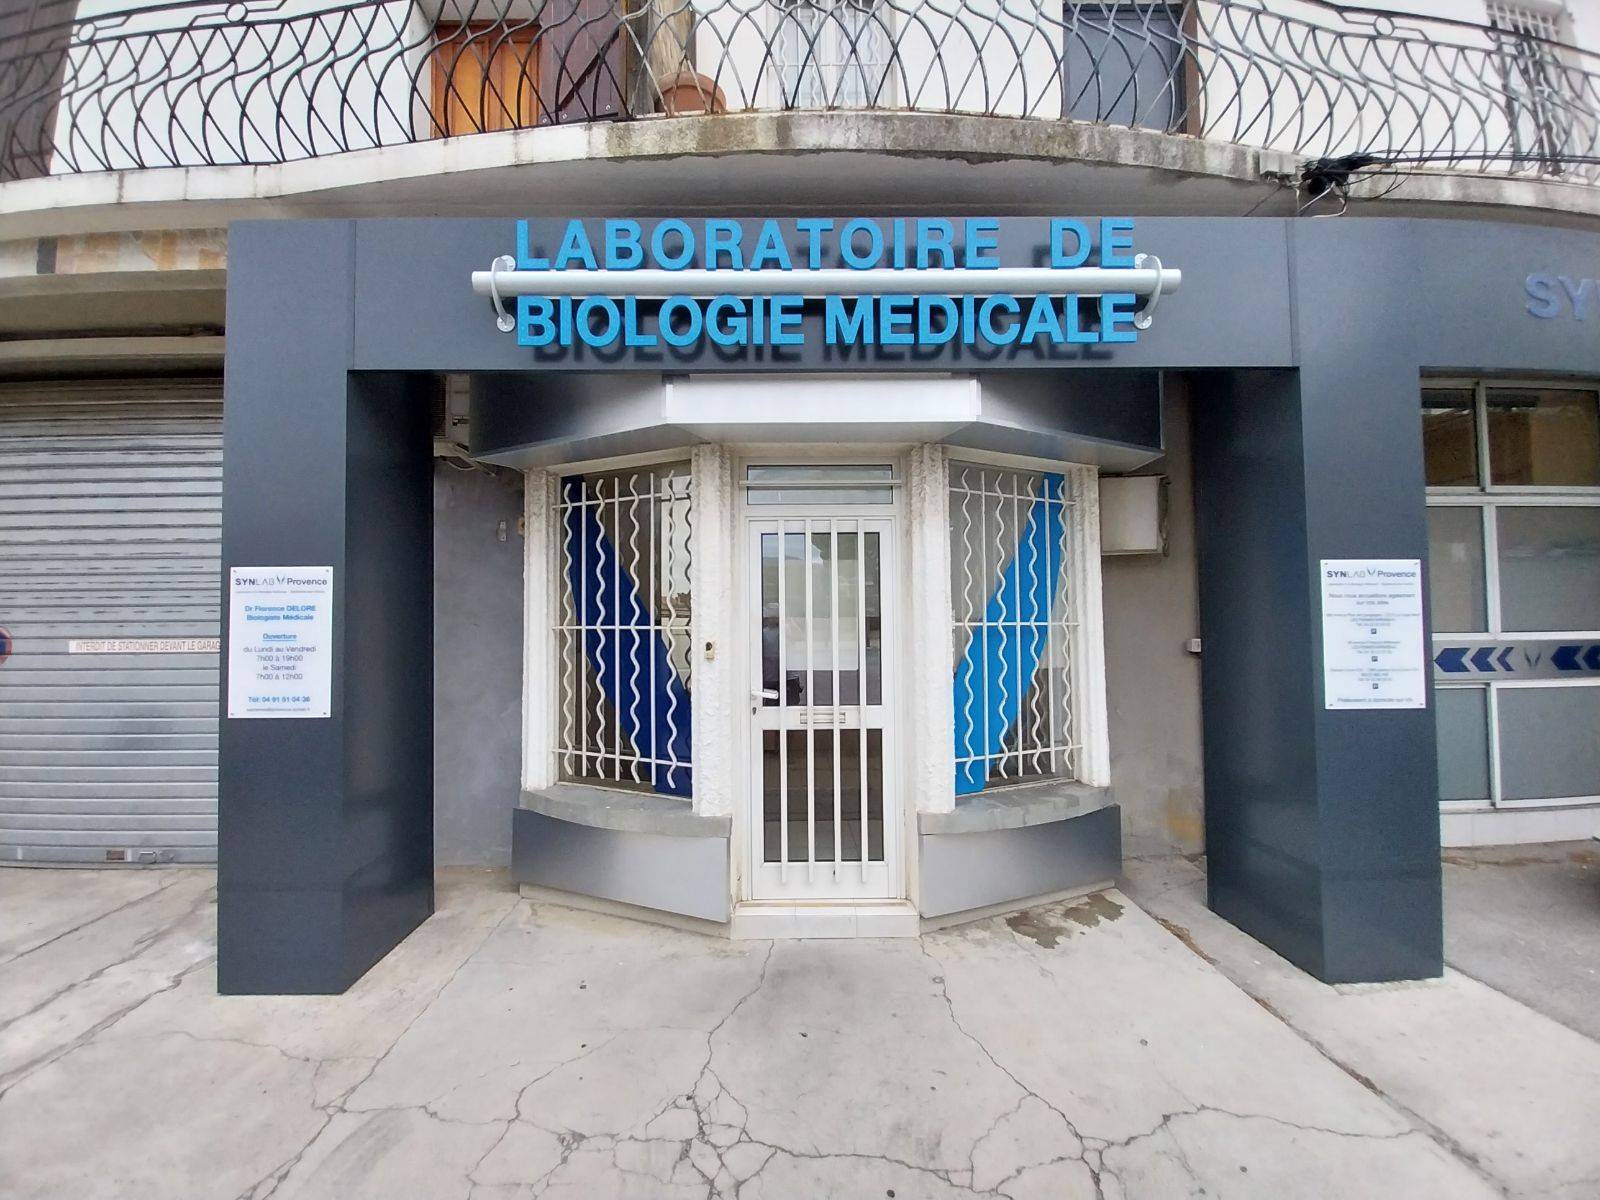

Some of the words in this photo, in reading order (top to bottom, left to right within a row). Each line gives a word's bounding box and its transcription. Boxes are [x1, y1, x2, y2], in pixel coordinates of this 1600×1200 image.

[516, 217, 1001, 271] LABORATOIRE
[1050, 216, 1136, 270] DE
[1525, 272, 1600, 321] SY
[516, 293, 806, 346] BIOLOGIE
[825, 293, 1139, 345] MEDICALE
[235, 577, 274, 586] SYNLAB
[287, 577, 327, 586] Provence
[1326, 570, 1366, 578] SYNLAB
[1377, 570, 1416, 578] Provence
[107, 641, 117, 651] DE
[118, 641, 159, 651] STATIONNER
[160, 641, 187, 651] DEVANT
[187, 641, 196, 651] LE
[197, 640, 220, 651] GARAG
